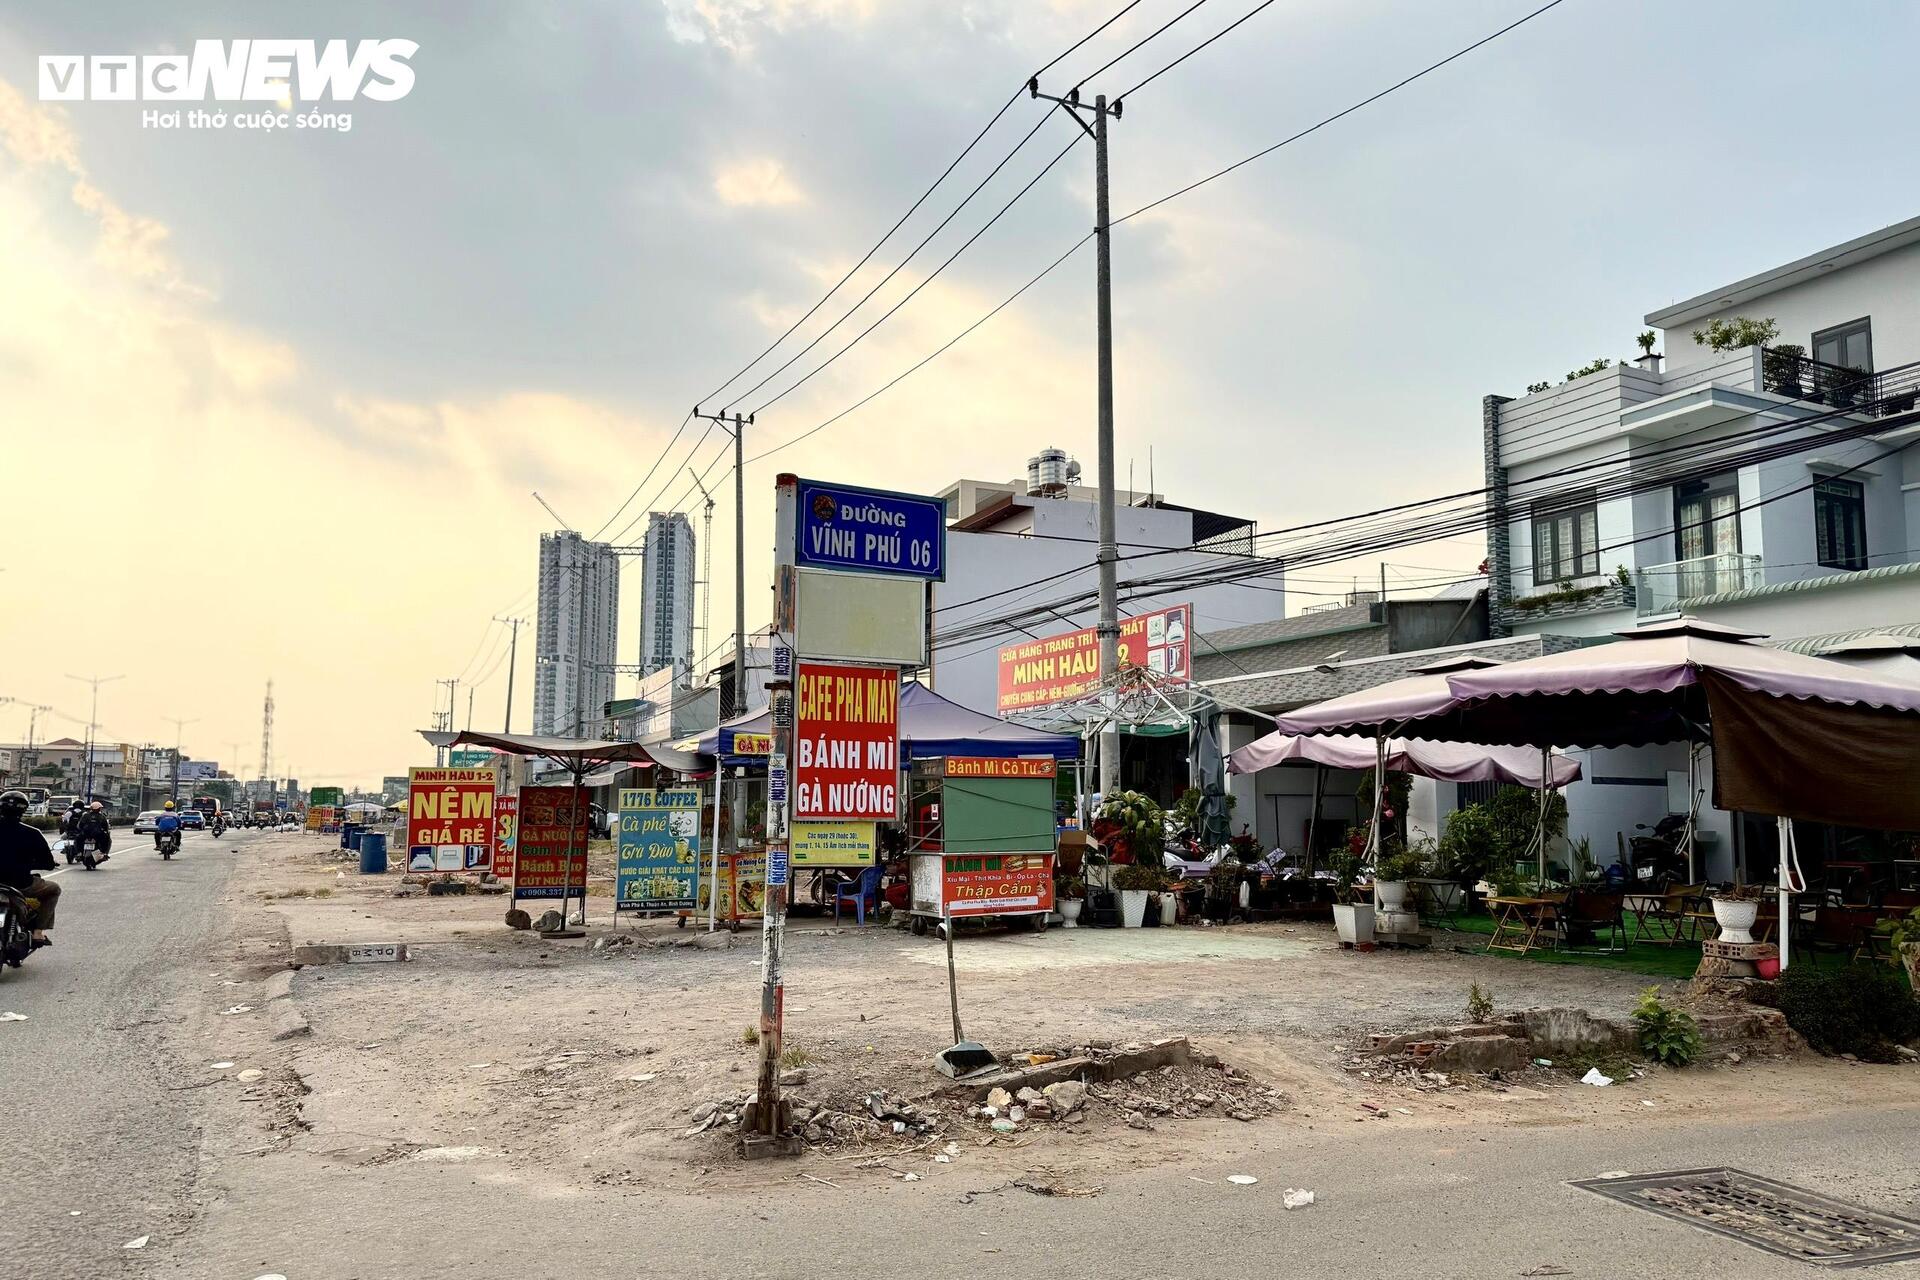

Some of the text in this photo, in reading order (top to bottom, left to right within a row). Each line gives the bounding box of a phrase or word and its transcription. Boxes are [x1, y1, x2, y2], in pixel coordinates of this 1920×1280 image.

[841, 503, 905, 527] ĐƯỜNG
[812, 522, 931, 567] VĨNH PHÚ 06
[1019, 641, 1042, 658] HÀNG
[1044, 637, 1074, 654] TRANG
[1078, 630, 1093, 647] TRÍ
[1013, 659, 1056, 685] MINH
[1059, 649, 1098, 679] HẬU
[798, 674, 832, 721] CAFE
[836, 677, 863, 722] PHA
[867, 670, 896, 724] MÁY
[736, 735, 754, 752] GÀ
[800, 733, 894, 770] BÁNH MÌ
[415, 771, 446, 780] MINH
[476, 772, 493, 781] 1-2
[948, 759, 981, 774] Bánh
[984, 760, 999, 774] Mì
[1002, 761, 1019, 775] Cô
[413, 786, 493, 825] NỆM
[623, 792, 697, 807] 1776 COFFEE
[798, 777, 823, 813] GÀ
[829, 777, 894, 814] NƯỚNG
[418, 823, 485, 844] GIÁ RẺ
[621, 815, 667, 835] Cà phê
[621, 843, 674, 860] Trà Đào
[521, 860, 554, 872] Bánh
[956, 880, 1032, 899] Thập Cẩm
